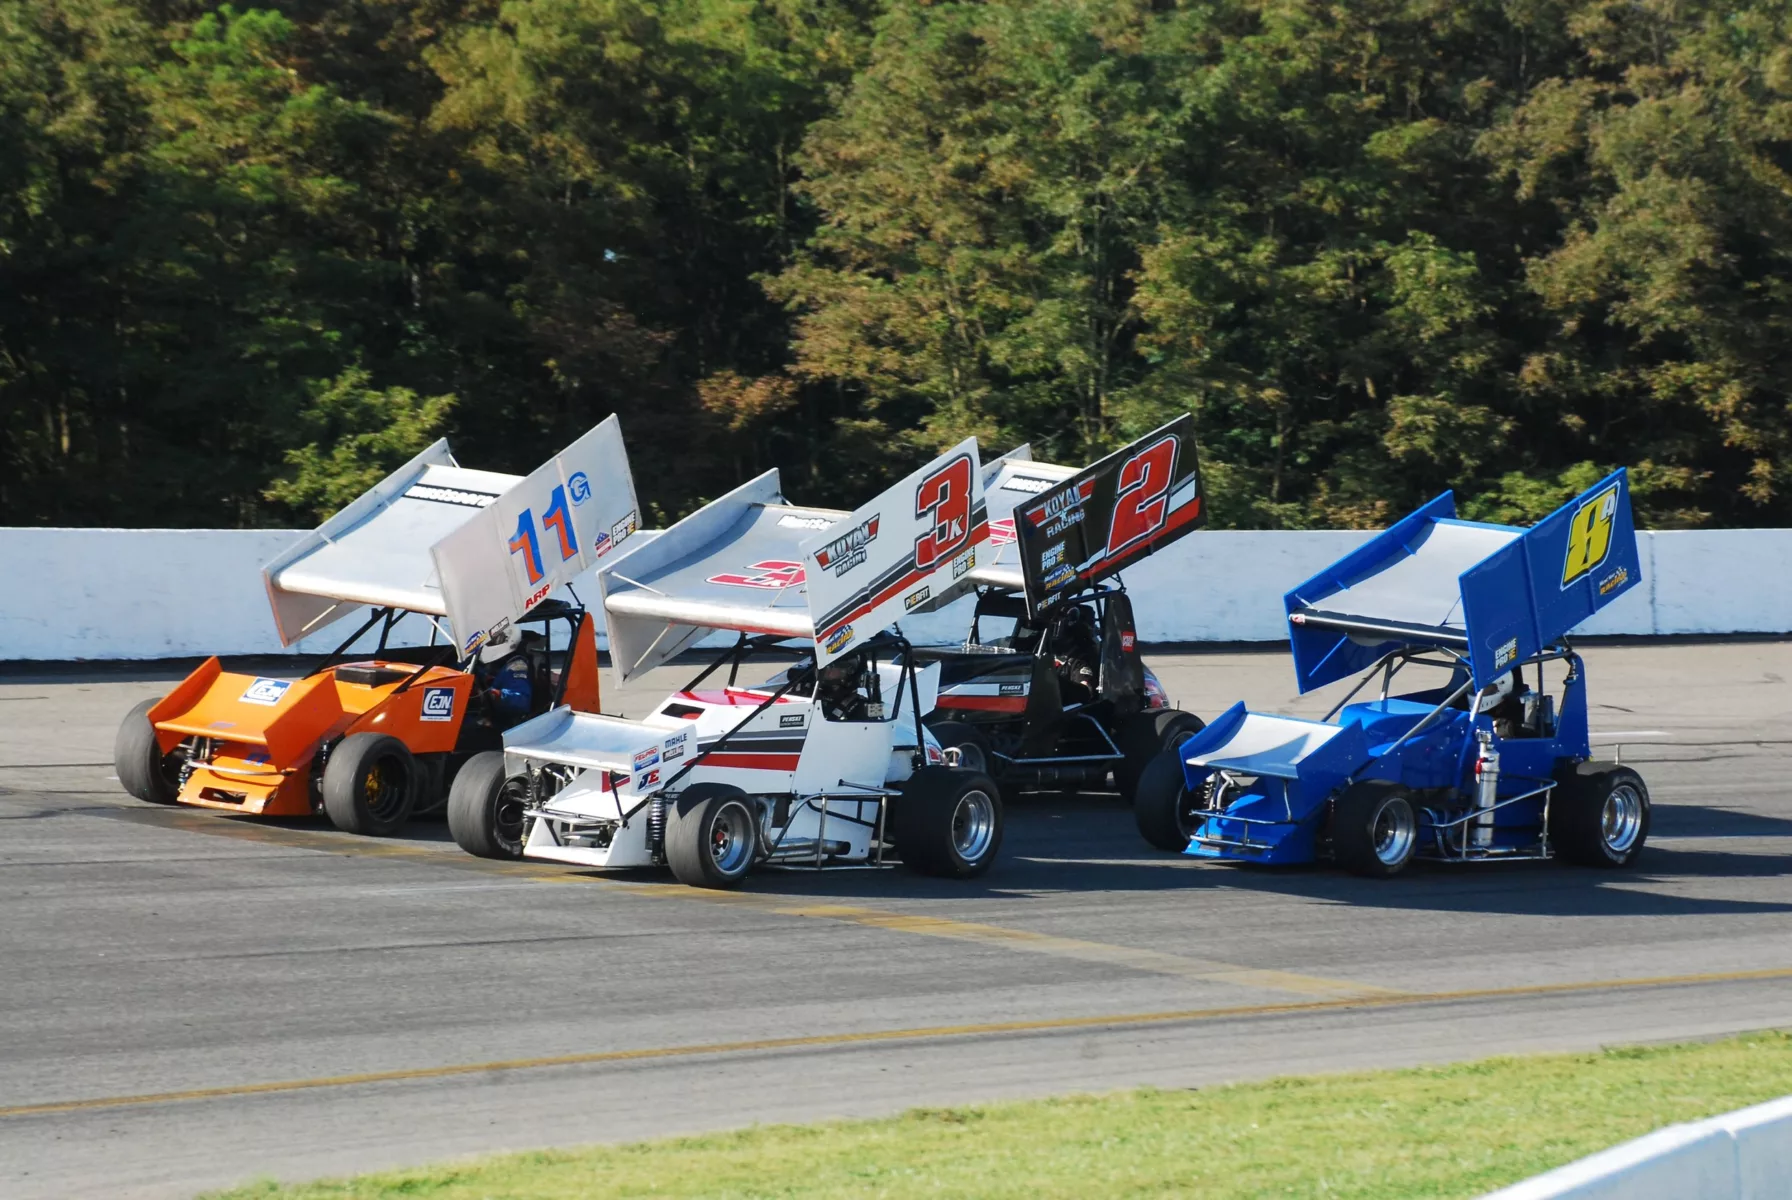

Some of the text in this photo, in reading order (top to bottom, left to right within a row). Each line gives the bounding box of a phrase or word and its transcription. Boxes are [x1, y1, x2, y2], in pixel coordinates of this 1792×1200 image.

[1043, 483, 1081, 518] KOYAN
[1105, 434, 1181, 559] 2
[914, 452, 974, 574] 3
[1046, 508, 1085, 538] RACING
[508, 484, 579, 586] 11
[826, 521, 871, 563] KOYAN
[1042, 541, 1065, 561] ENGINE
[1042, 555, 1056, 571] PRO
[525, 584, 550, 610] ARP
[1495, 637, 1516, 660] ENGINE
[1495, 654, 1508, 669] PRO
[423, 689, 452, 715] CEJN
[665, 733, 688, 748] MAHLE
[637, 769, 661, 790] JE
